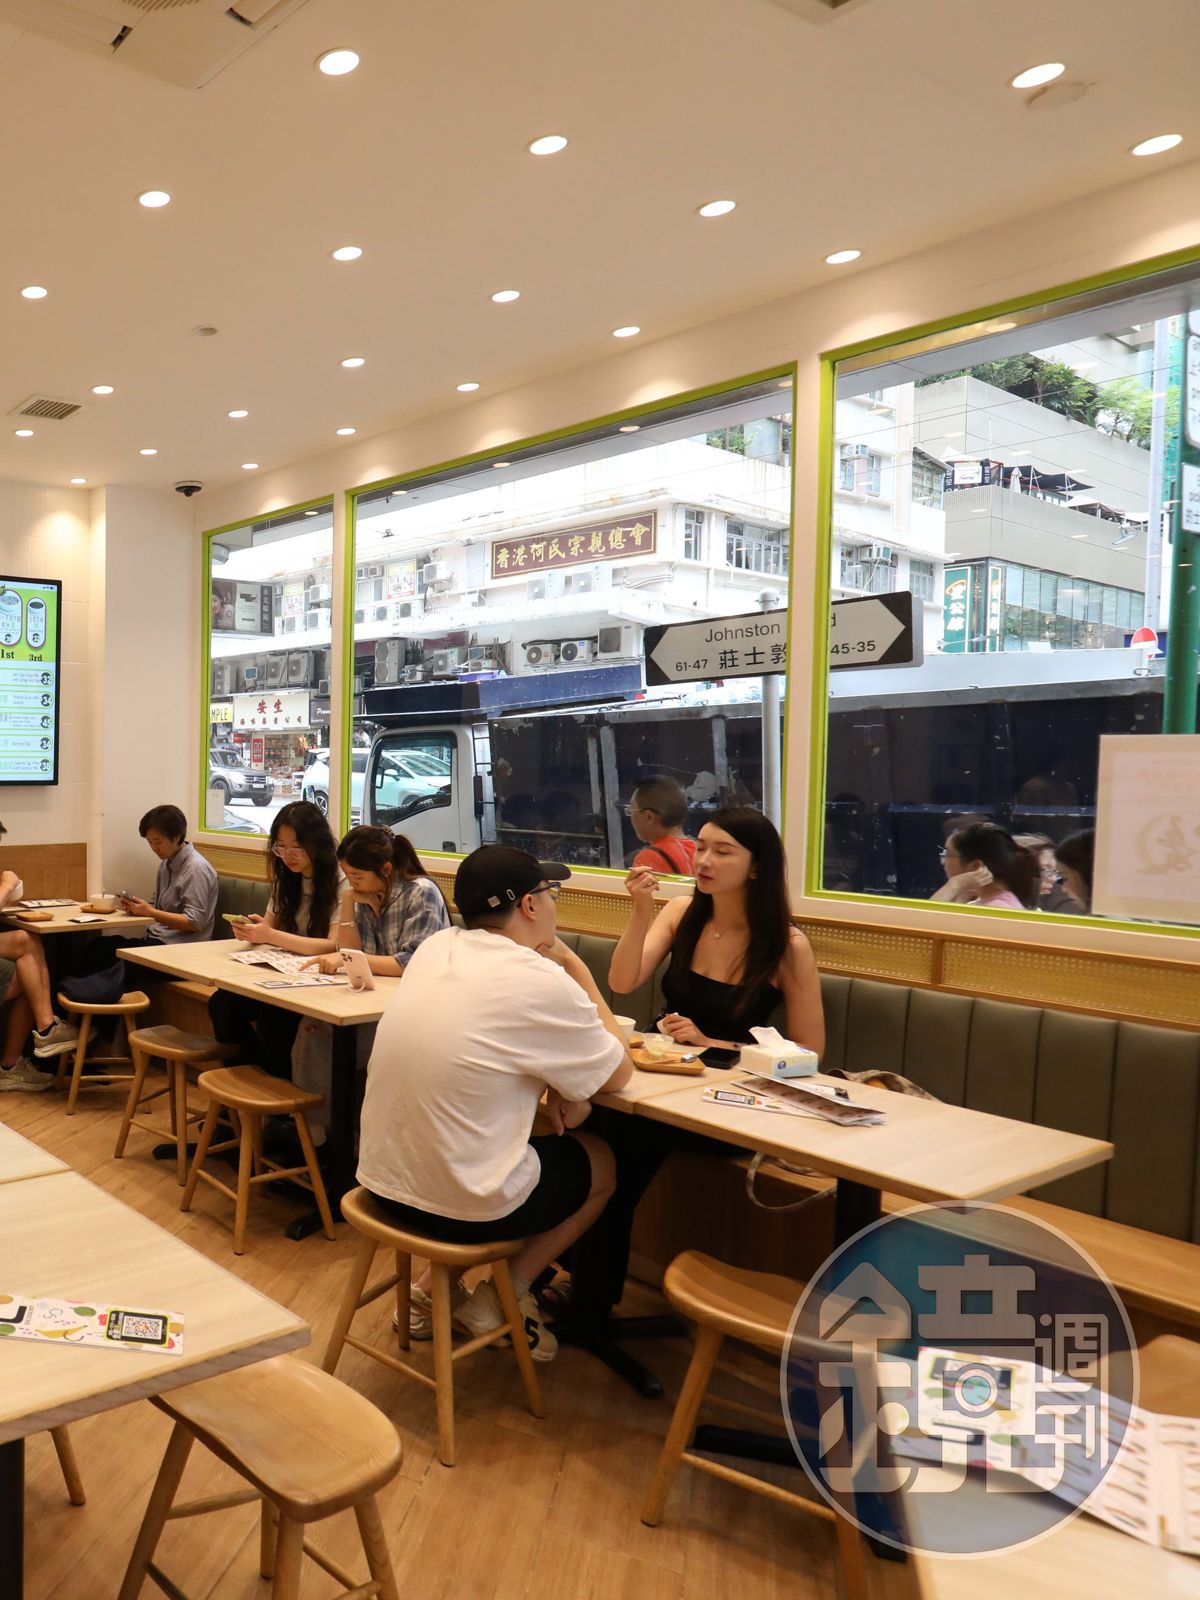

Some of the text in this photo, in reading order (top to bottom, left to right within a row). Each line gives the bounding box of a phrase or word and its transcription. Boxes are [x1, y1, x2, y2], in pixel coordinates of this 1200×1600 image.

[496, 522, 650, 569] 香港何氏宗親總會
[704, 621, 781, 643] Johnston
[1, 649, 15, 659] 1st
[831, 640, 876, 656] 45-35
[29, 654, 43, 662] 3rd
[675, 659, 708, 672] 61-47
[257, 699, 283, 714] 安生
